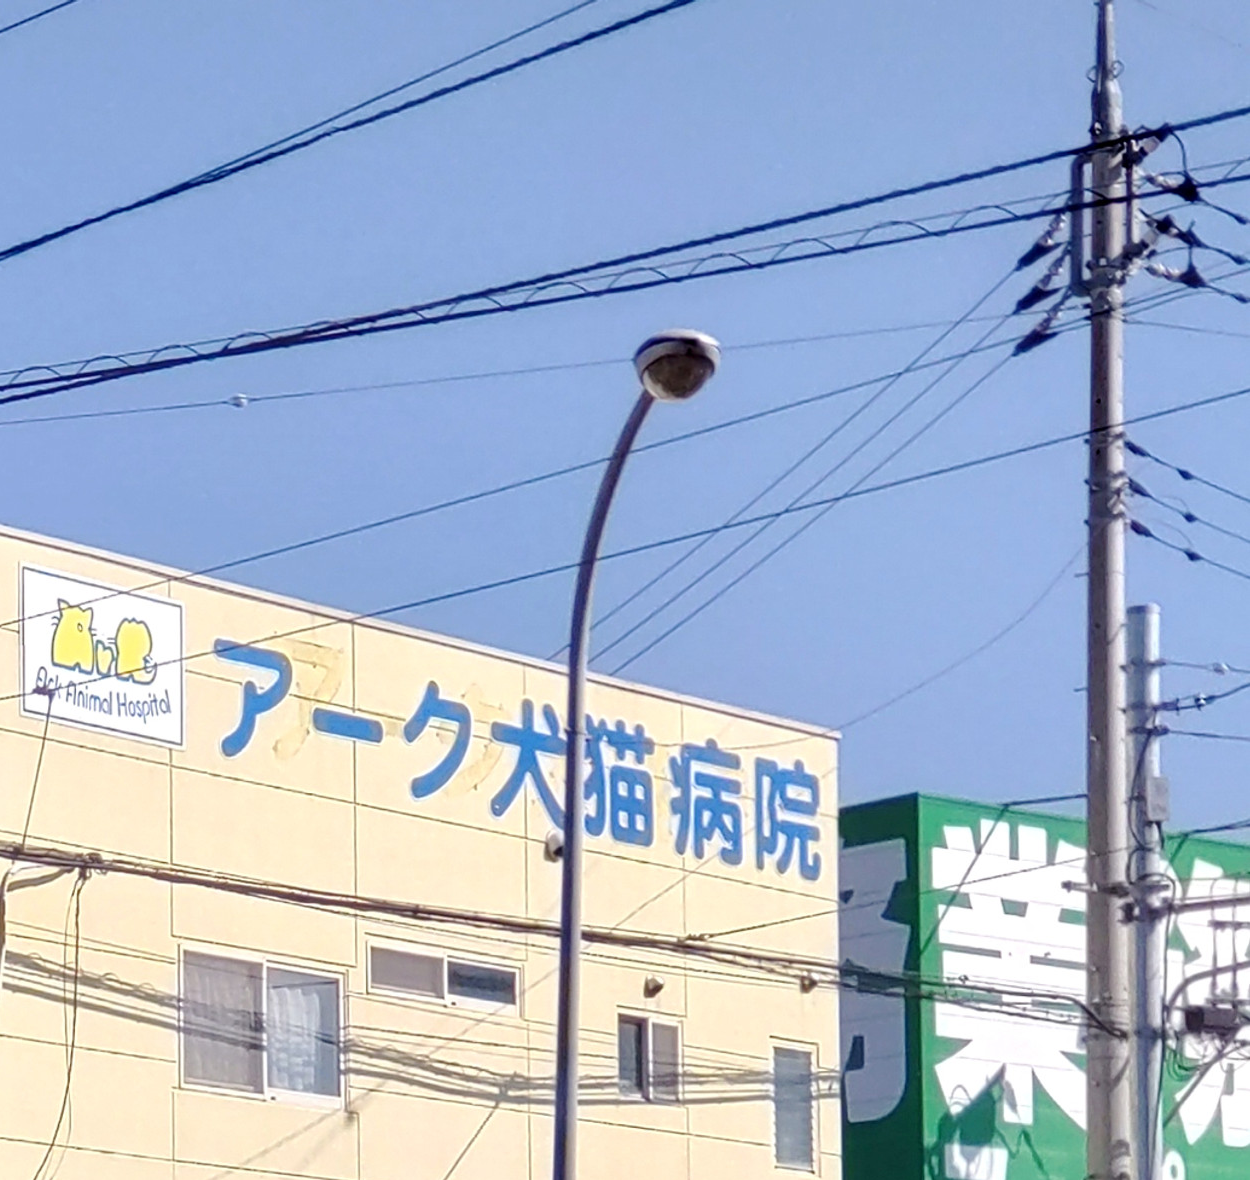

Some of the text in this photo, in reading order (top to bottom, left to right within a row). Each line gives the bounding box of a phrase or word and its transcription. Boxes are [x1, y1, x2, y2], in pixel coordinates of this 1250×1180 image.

[66, 681, 113, 716] Animal
[117, 689, 172, 724] Hospital
[213, 637, 823, 883] アーク犬猫病院
